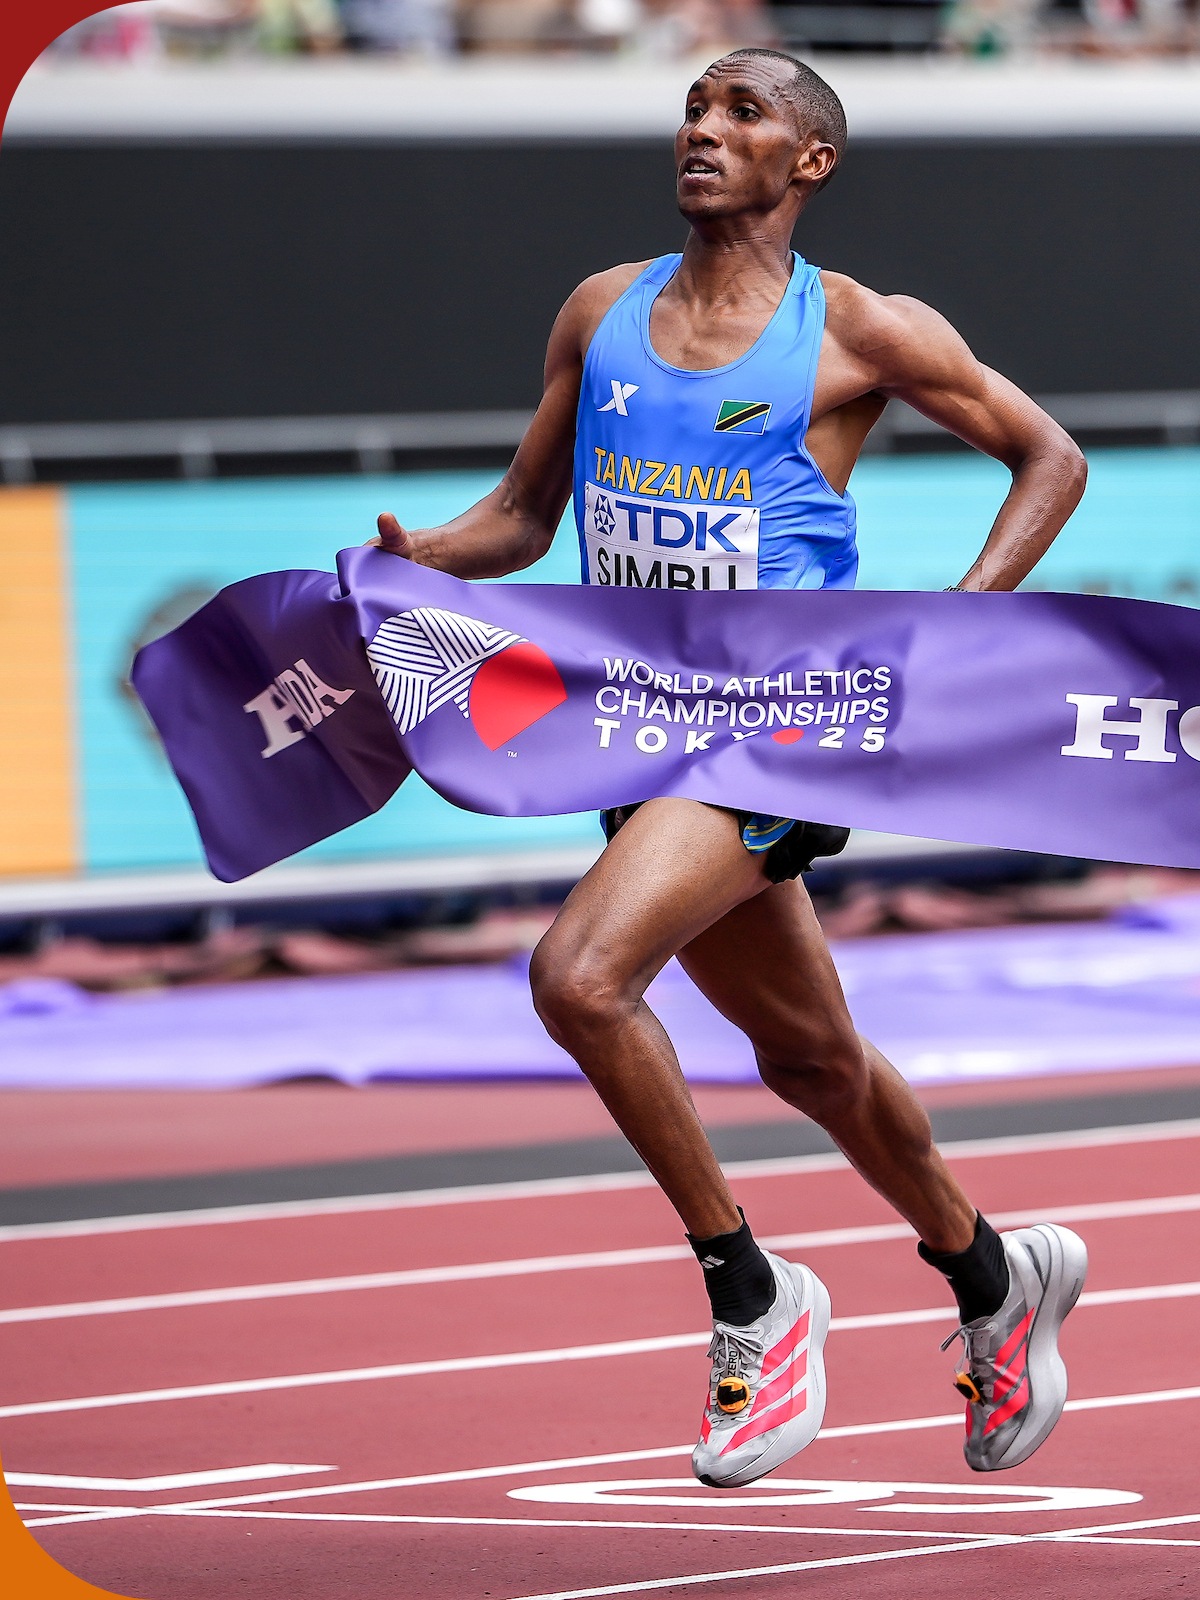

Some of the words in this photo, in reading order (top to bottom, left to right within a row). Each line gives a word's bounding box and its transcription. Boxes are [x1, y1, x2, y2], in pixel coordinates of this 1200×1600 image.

[593, 447, 753, 501] TANZANIA
[615, 500, 742, 552] TDK
[602, 657, 714, 694] WORLD
[721, 666, 892, 697] ATHLETICS
[595, 686, 890, 727] CHAMPIONSHIPS
